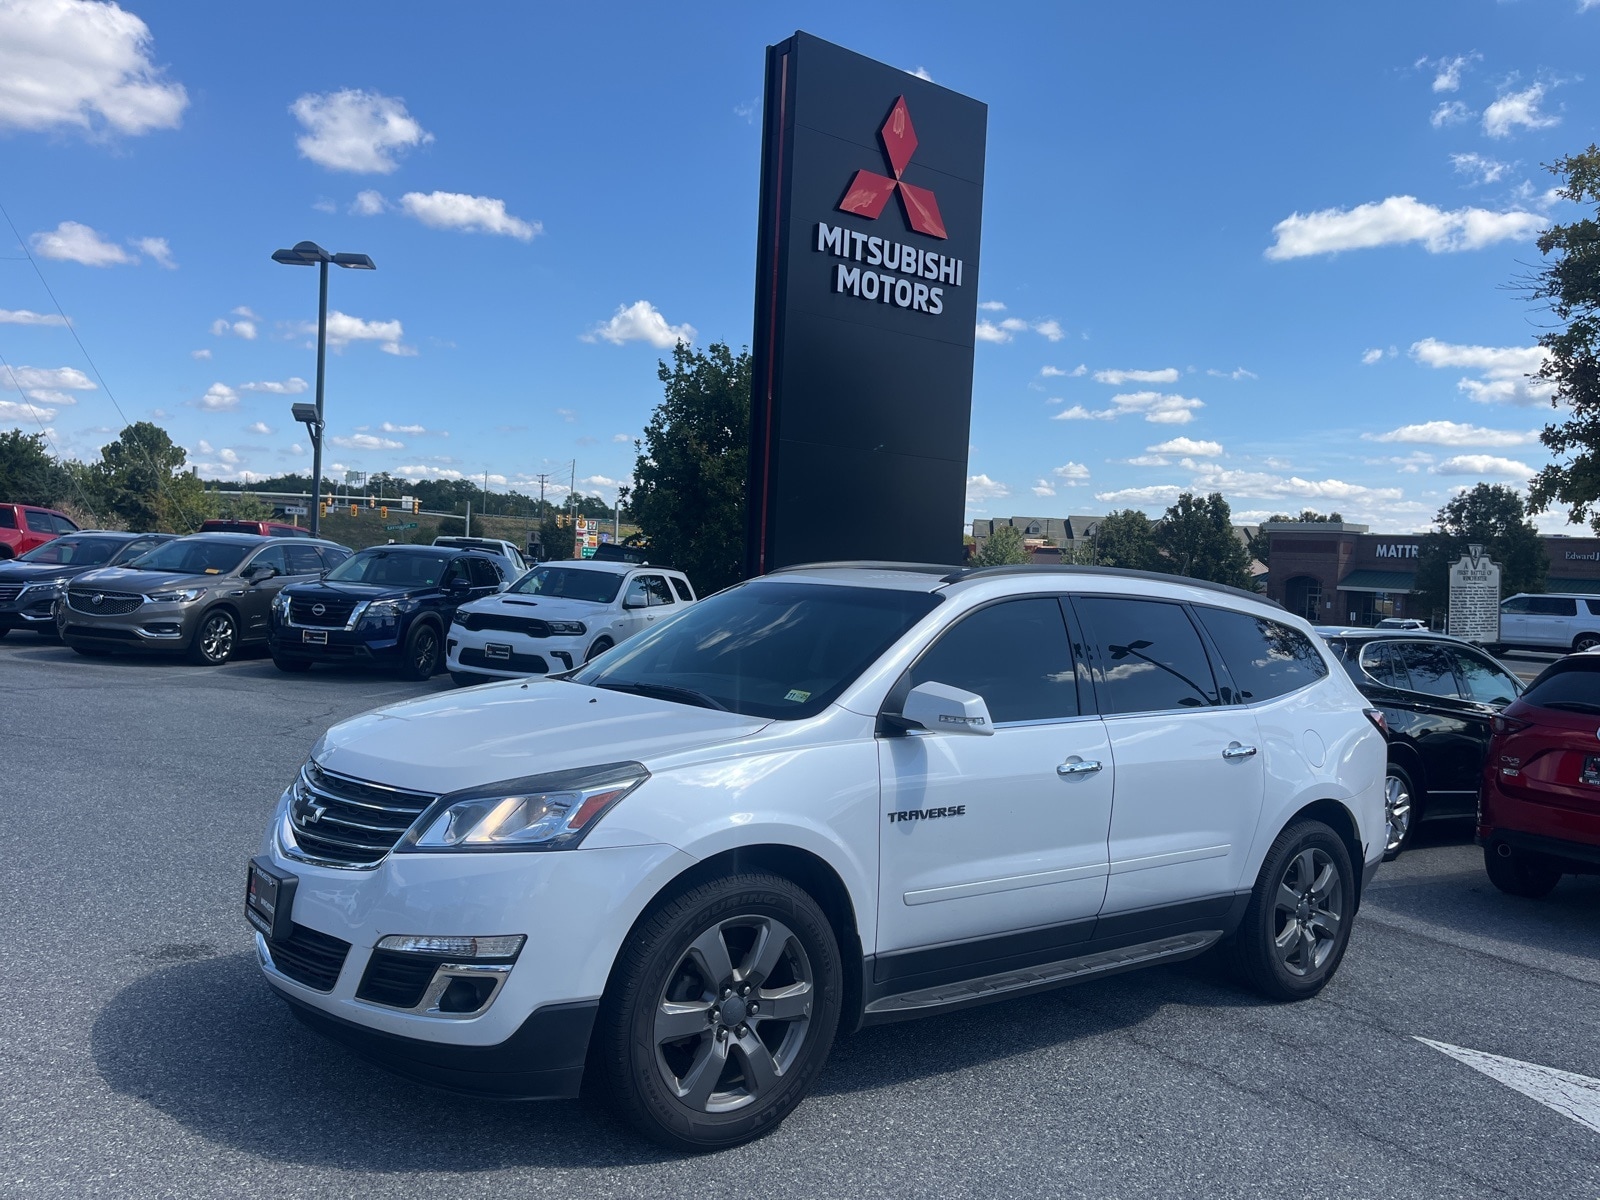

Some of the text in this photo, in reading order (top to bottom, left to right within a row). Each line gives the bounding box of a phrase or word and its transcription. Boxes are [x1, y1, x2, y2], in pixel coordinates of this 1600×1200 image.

[817, 221, 963, 287] MITSUBISHI
[836, 263, 944, 315] MOTORS
[1565, 551, 1595, 560] Edward
[1500, 755, 1520, 764] CX-5
[887, 804, 966, 823] TRAVERSE
[683, 893, 780, 936] TOURING
[750, 1062, 815, 1130] KELLY
